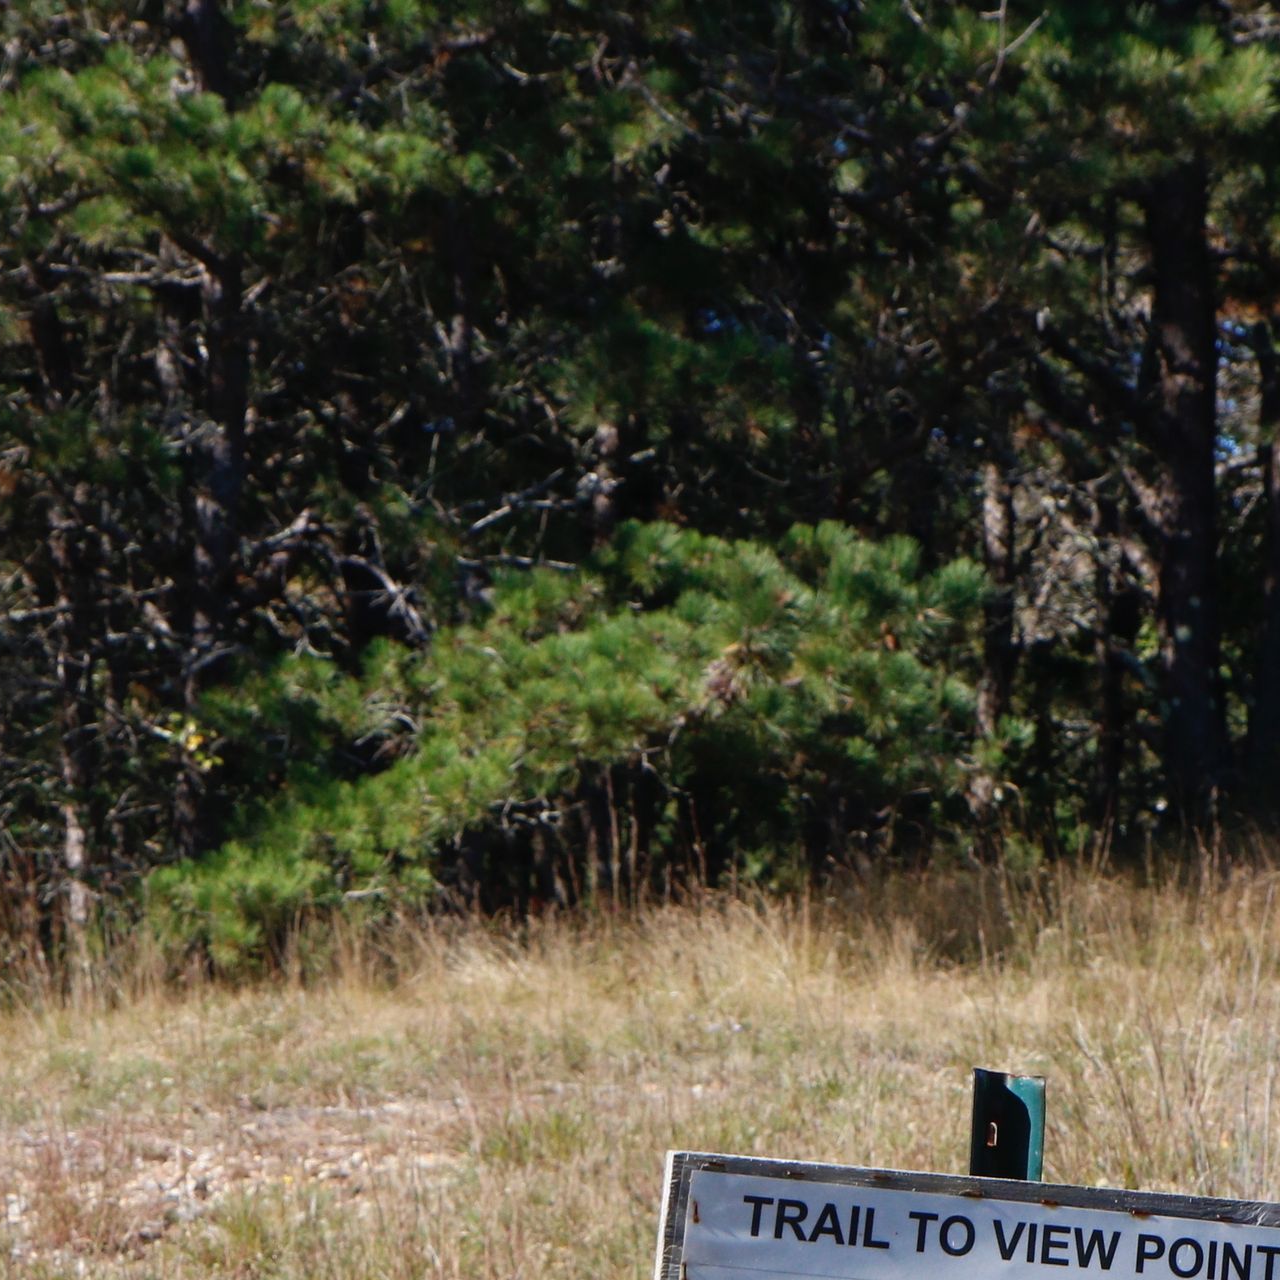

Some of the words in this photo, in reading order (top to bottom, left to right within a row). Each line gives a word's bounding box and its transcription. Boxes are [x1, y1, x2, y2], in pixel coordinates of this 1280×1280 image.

[742, 1194, 891, 1250] TRAIL
[908, 1210, 976, 1257] TO
[992, 1218, 1121, 1271] VIEW
